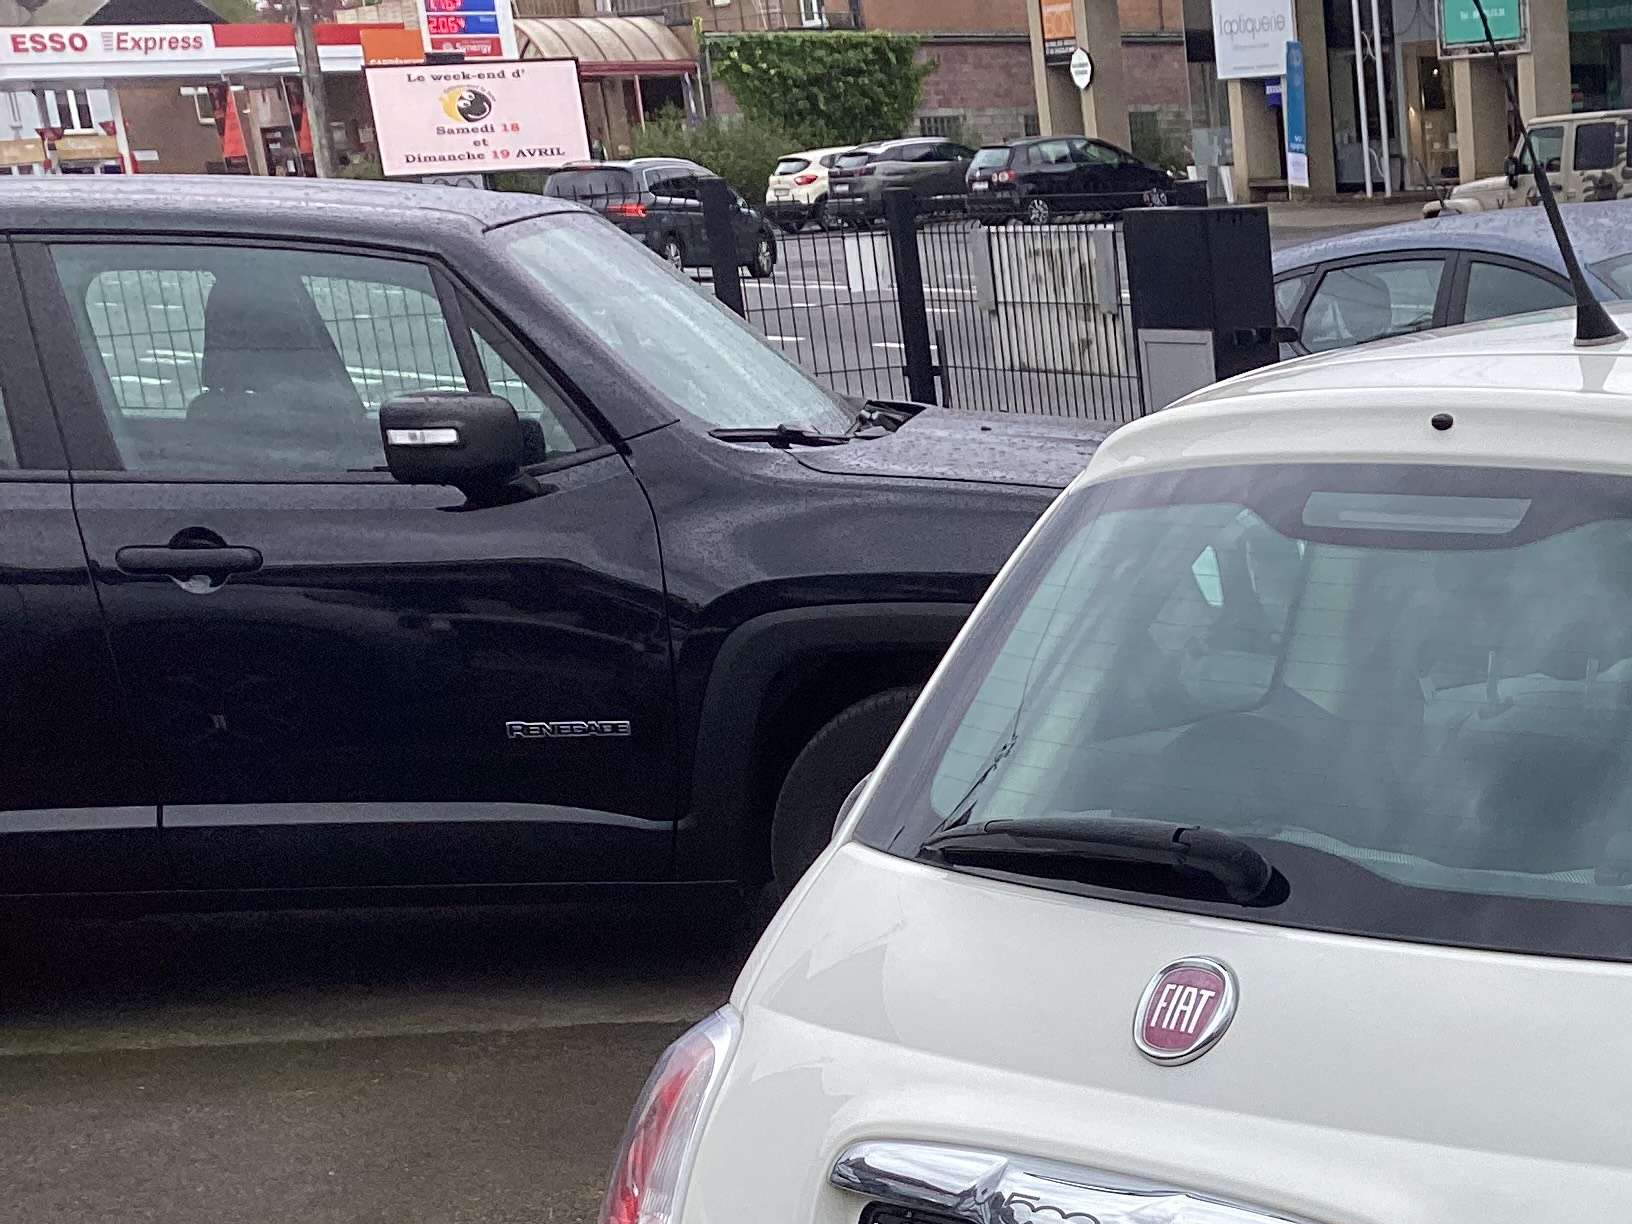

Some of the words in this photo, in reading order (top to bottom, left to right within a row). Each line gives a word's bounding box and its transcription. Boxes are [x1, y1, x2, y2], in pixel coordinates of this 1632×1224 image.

[10, 32, 88, 53] ESSO
[116, 31, 204, 55] Express
[407, 73, 425, 83] Le
[431, 70, 506, 82] week-end
[436, 123, 496, 136] Samedi
[501, 122, 521, 134] 18
[472, 138, 489, 148] et
[405, 150, 486, 164] Dimanche
[491, 149, 511, 160] 19
[516, 147, 566, 159] AVRIL
[505, 720, 632, 739] RENEGADE
[1149, 982, 1217, 1035] FIAT
